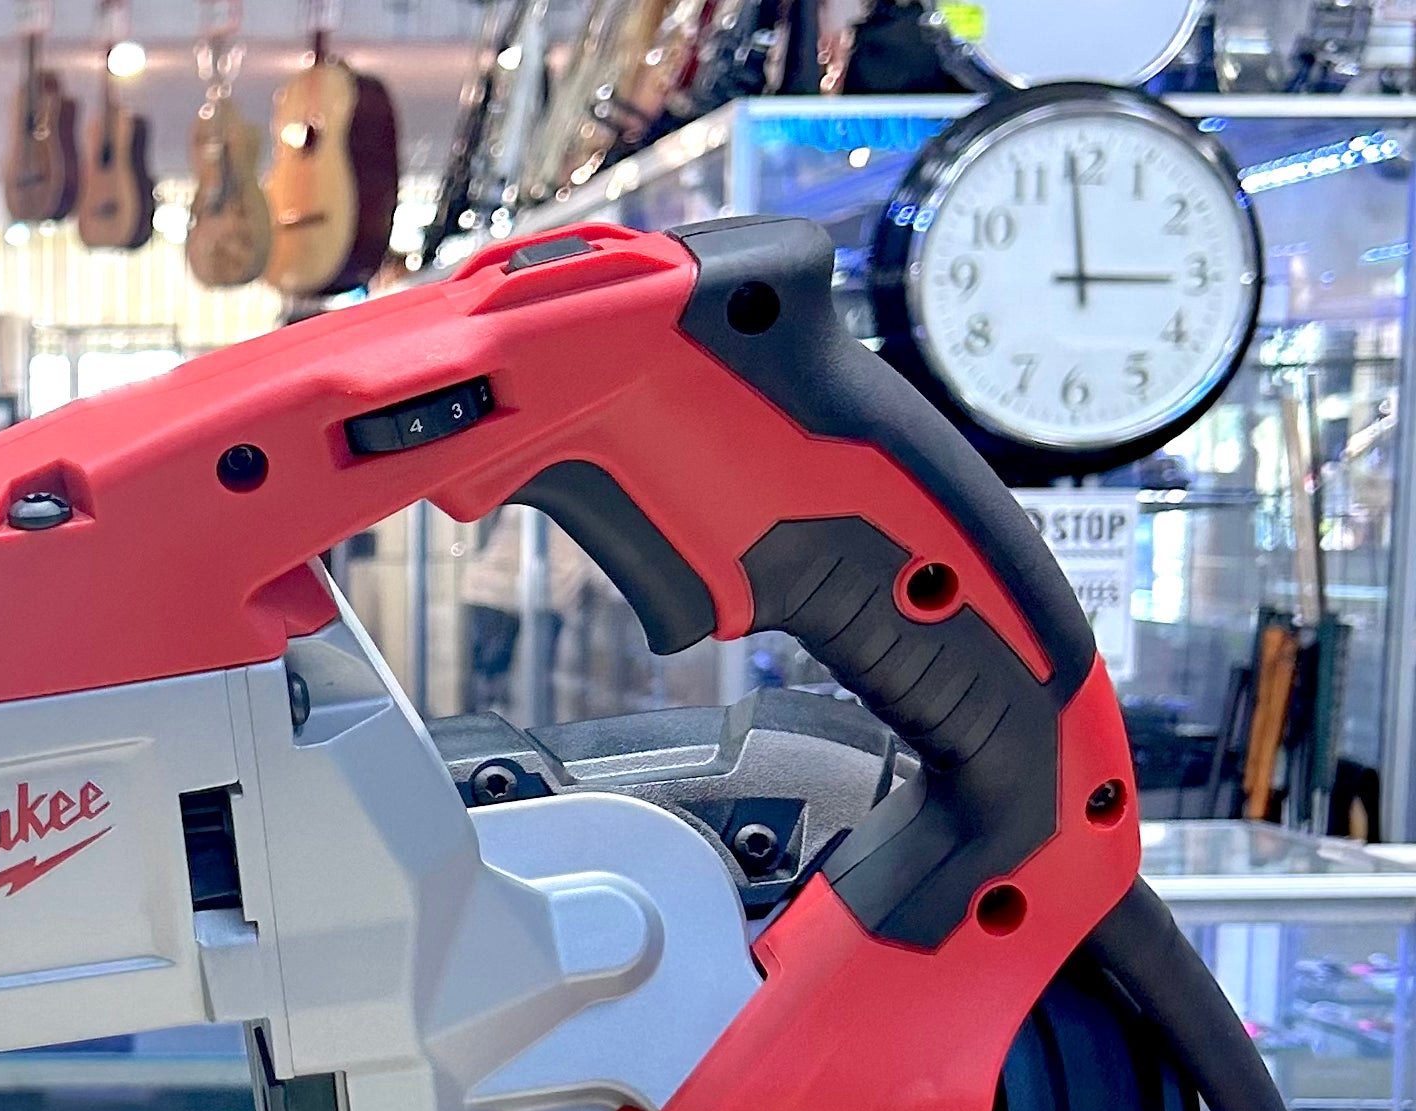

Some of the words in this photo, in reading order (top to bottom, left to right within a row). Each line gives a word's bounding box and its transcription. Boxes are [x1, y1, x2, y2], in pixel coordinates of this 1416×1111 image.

[1014, 161, 1048, 204] 11
[1064, 145, 1106, 185] 12
[1132, 161, 1145, 199] 1
[971, 207, 1016, 251] 10
[1161, 197, 1190, 235] 2
[950, 256, 979, 300] 9
[1187, 254, 1209, 295] 3
[963, 314, 993, 355] 8
[1160, 309, 1187, 344] 4
[1010, 353, 1038, 394] 7
[1061, 365, 1088, 409] 6
[1125, 353, 1150, 394] 5
[409, 418, 424, 433] 4
[451, 402, 463, 419] 3
[1053, 511, 1126, 541] STOP
